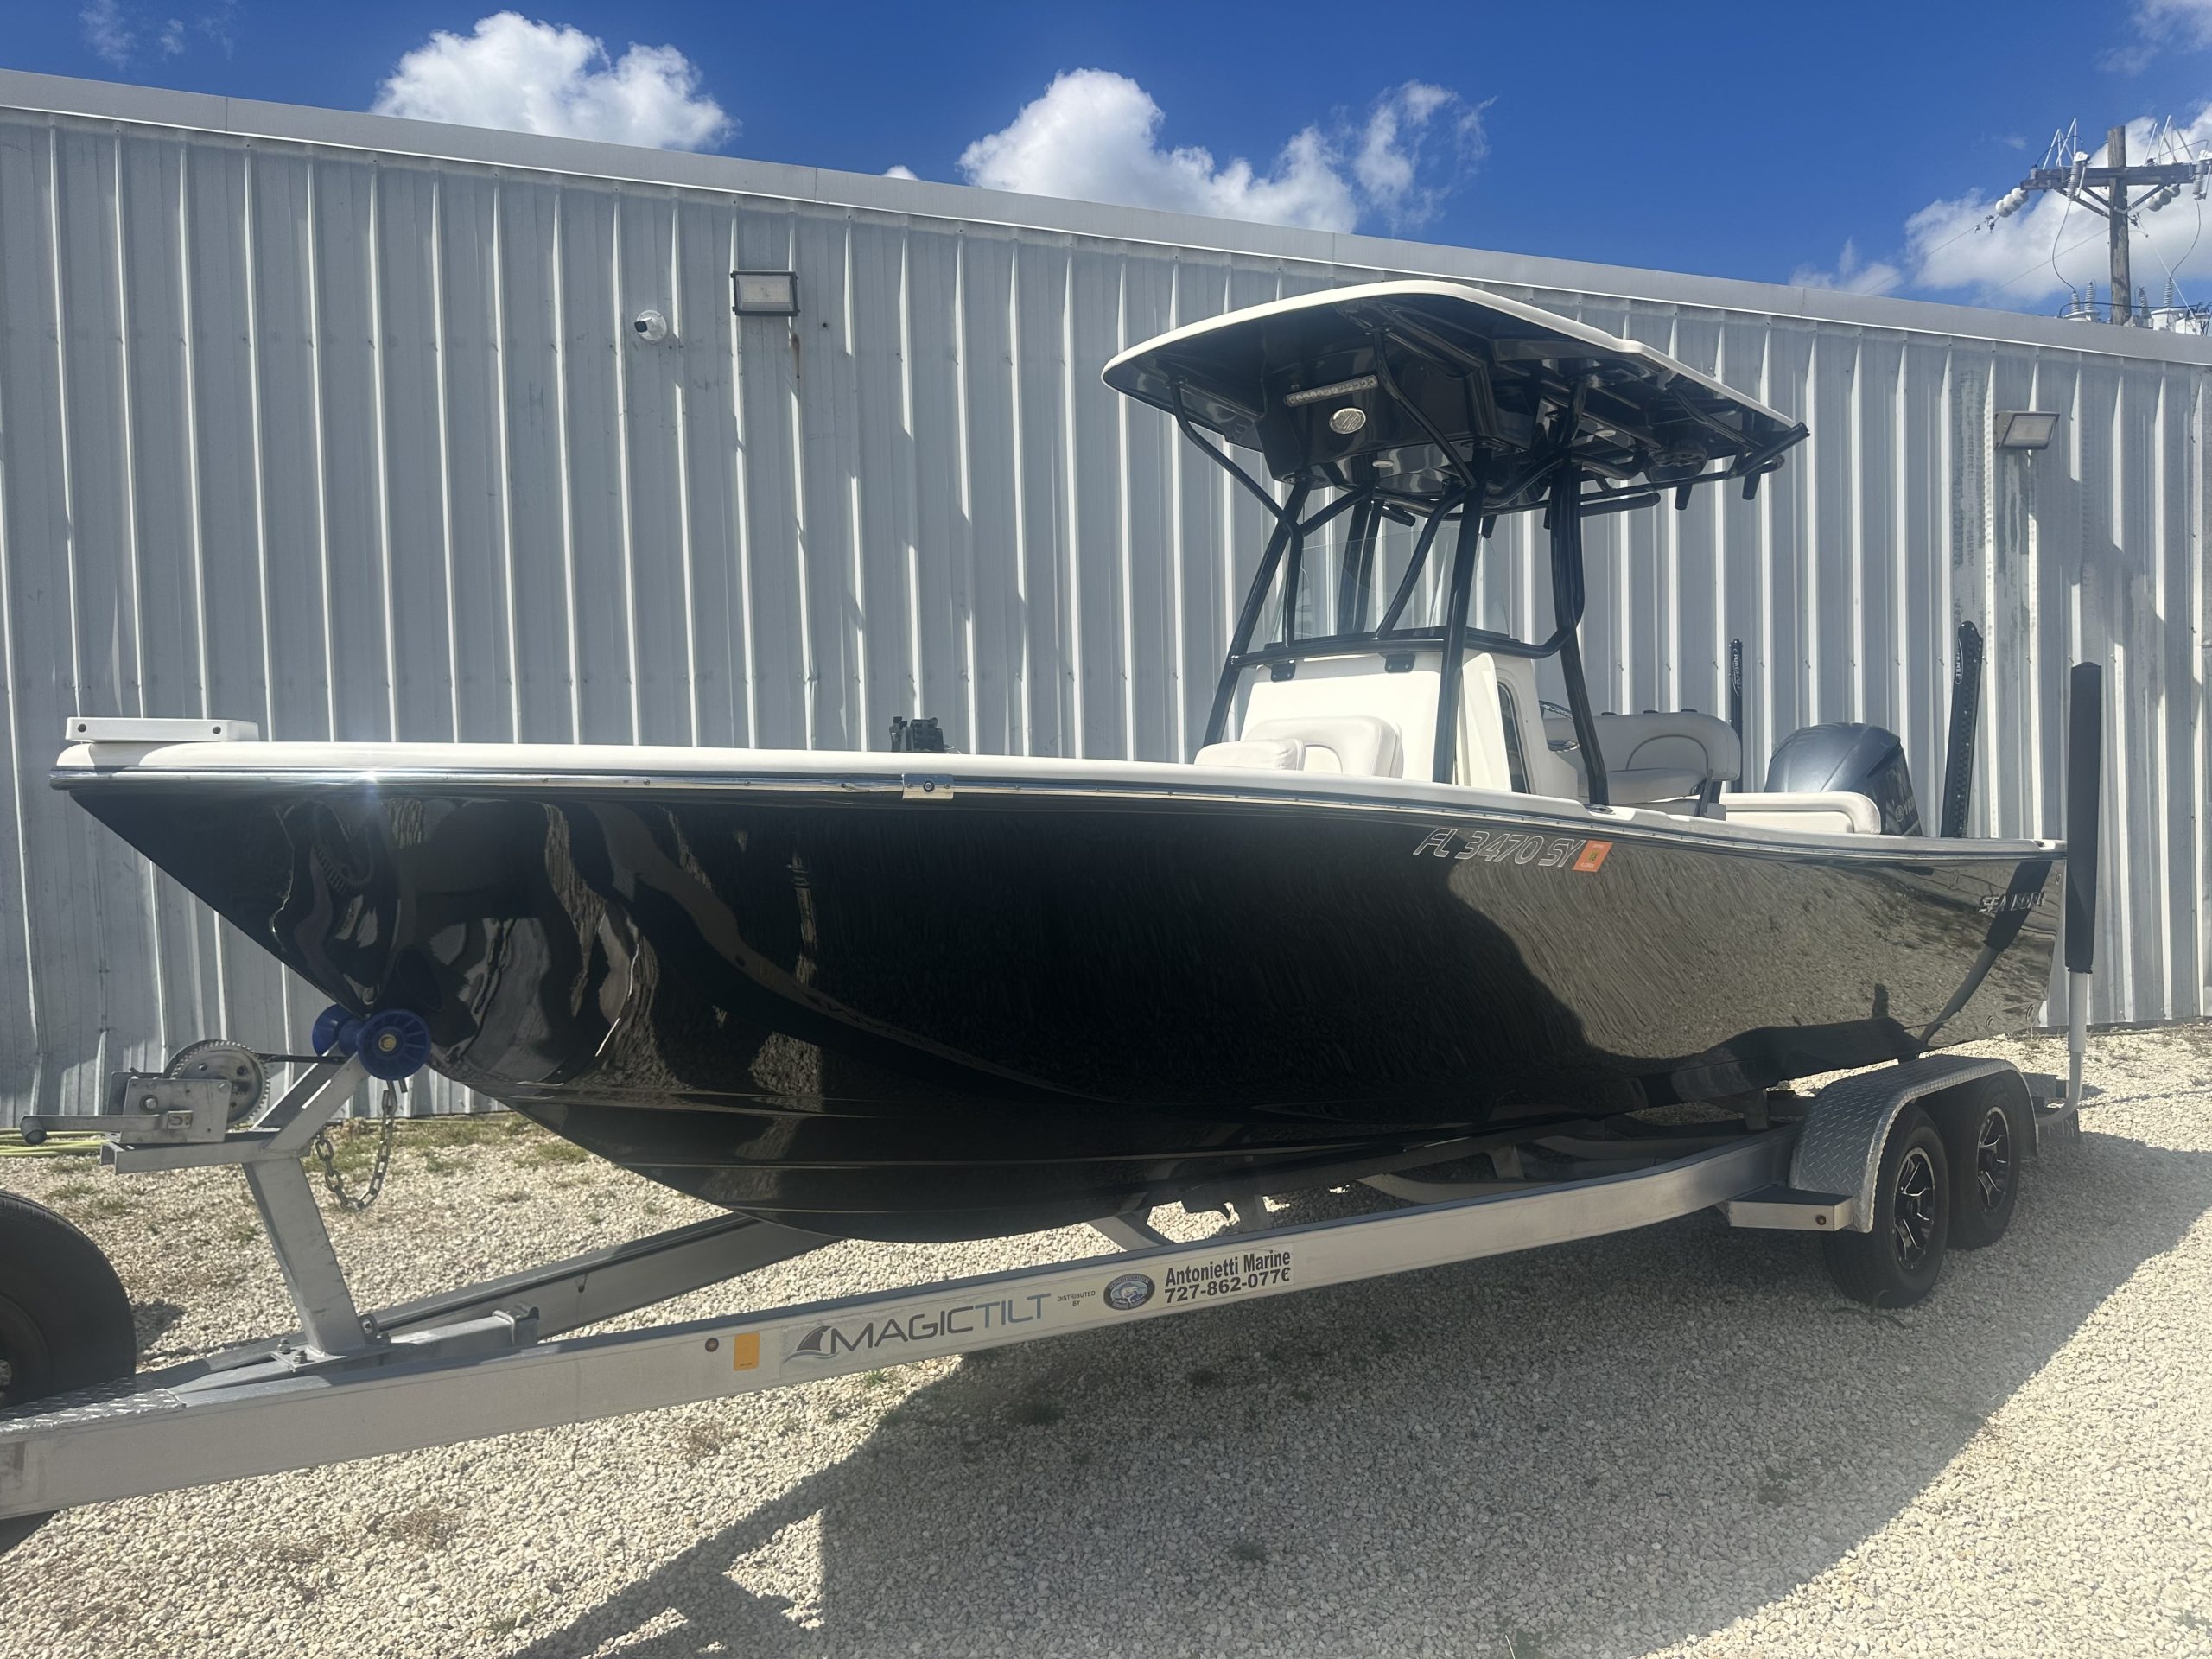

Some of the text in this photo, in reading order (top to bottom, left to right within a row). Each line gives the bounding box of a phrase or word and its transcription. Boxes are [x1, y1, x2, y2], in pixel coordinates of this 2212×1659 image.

[1413, 828, 1459, 858] FL
[1454, 830, 1545, 865] 3470
[1537, 837, 1586, 868] SY
[1165, 1256, 1239, 1287] Antonietti
[1243, 1249, 1292, 1274] Marine
[1057, 1290, 1096, 1302] DISTRIBUTED
[830, 1292, 1052, 1355] MAGICTILT
